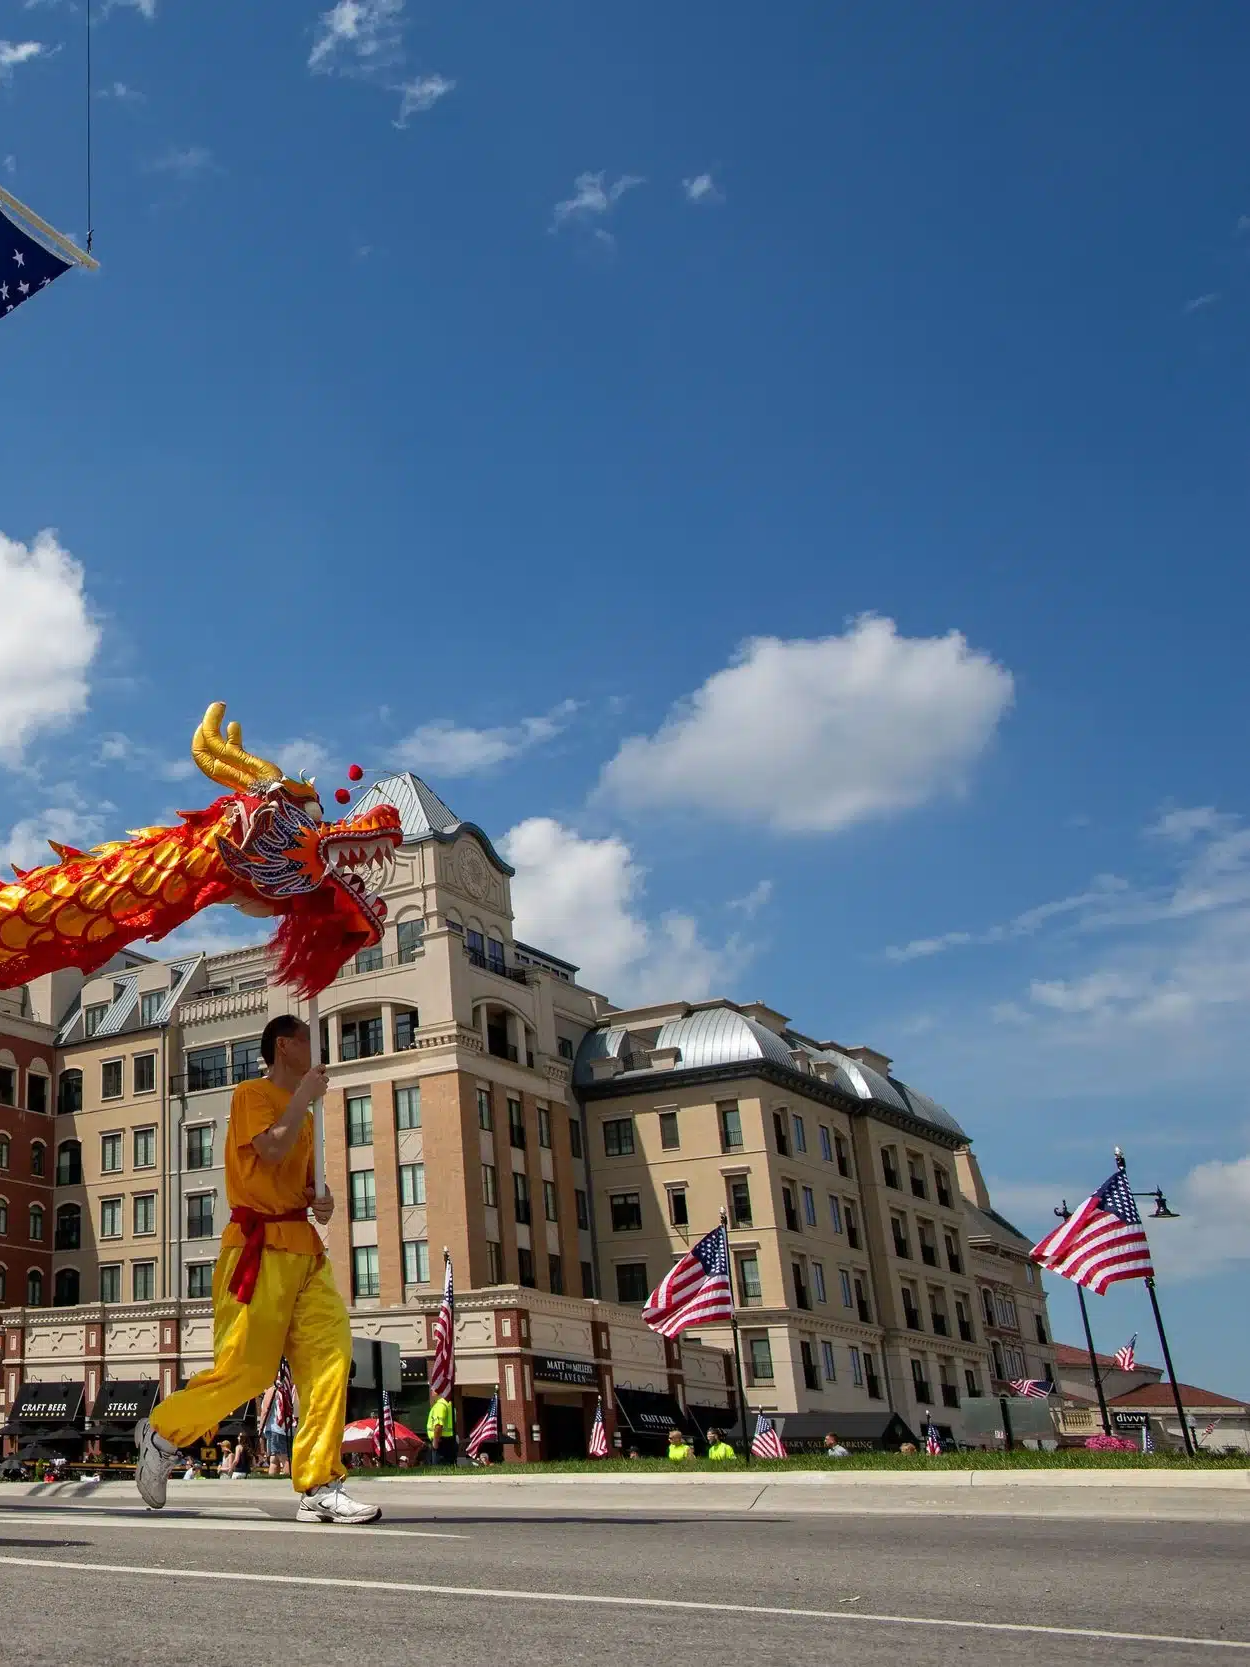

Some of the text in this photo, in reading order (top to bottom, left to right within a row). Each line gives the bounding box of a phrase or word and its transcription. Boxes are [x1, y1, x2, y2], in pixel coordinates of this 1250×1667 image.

[546, 1360, 565, 1371] MATT
[558, 1371, 587, 1384] TAVERN
[21, 1403, 67, 1412] CRAFT BEER
[107, 1402, 139, 1411] STEAKS
[640, 1413, 676, 1425] CRAFT BEER
